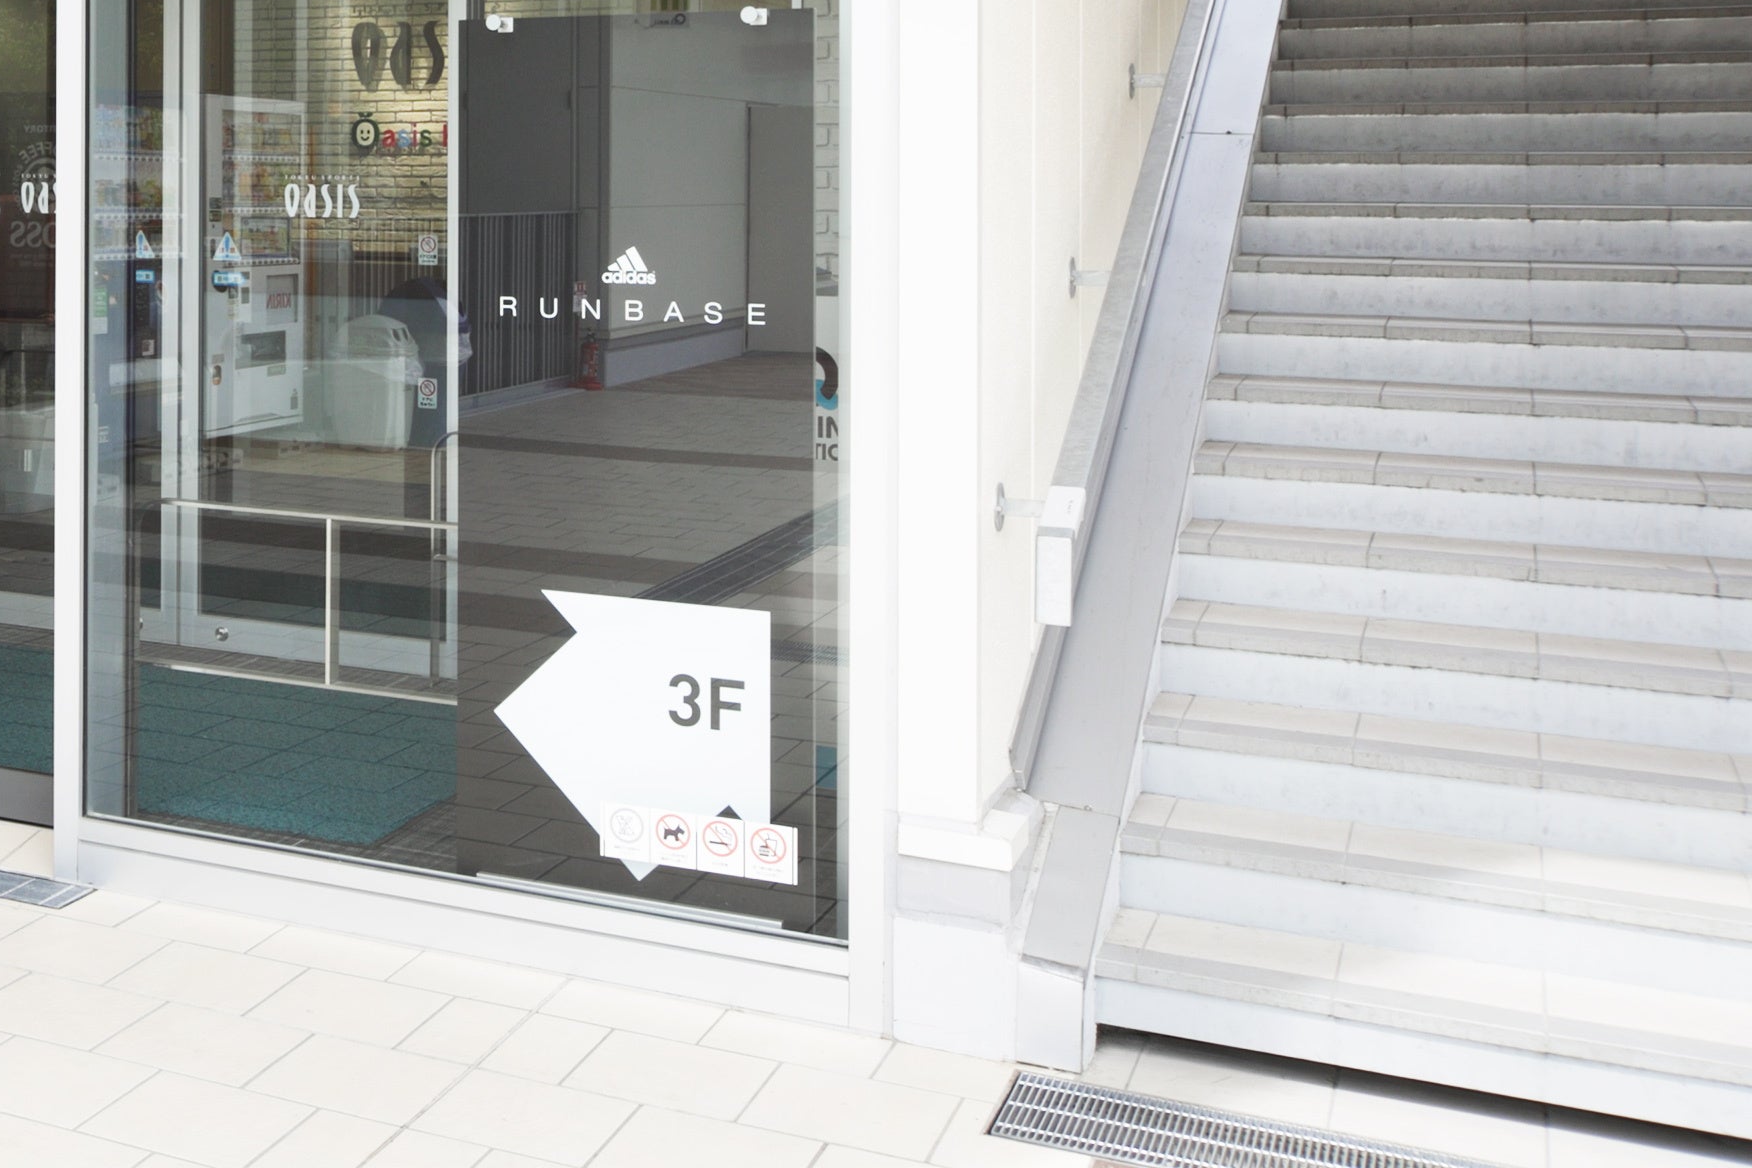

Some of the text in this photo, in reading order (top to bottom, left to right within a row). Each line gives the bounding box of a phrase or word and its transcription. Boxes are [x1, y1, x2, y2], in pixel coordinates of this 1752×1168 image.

[601, 270, 656, 285] adidas
[500, 296, 766, 326] RUNBASE
[669, 674, 745, 731] 3F
